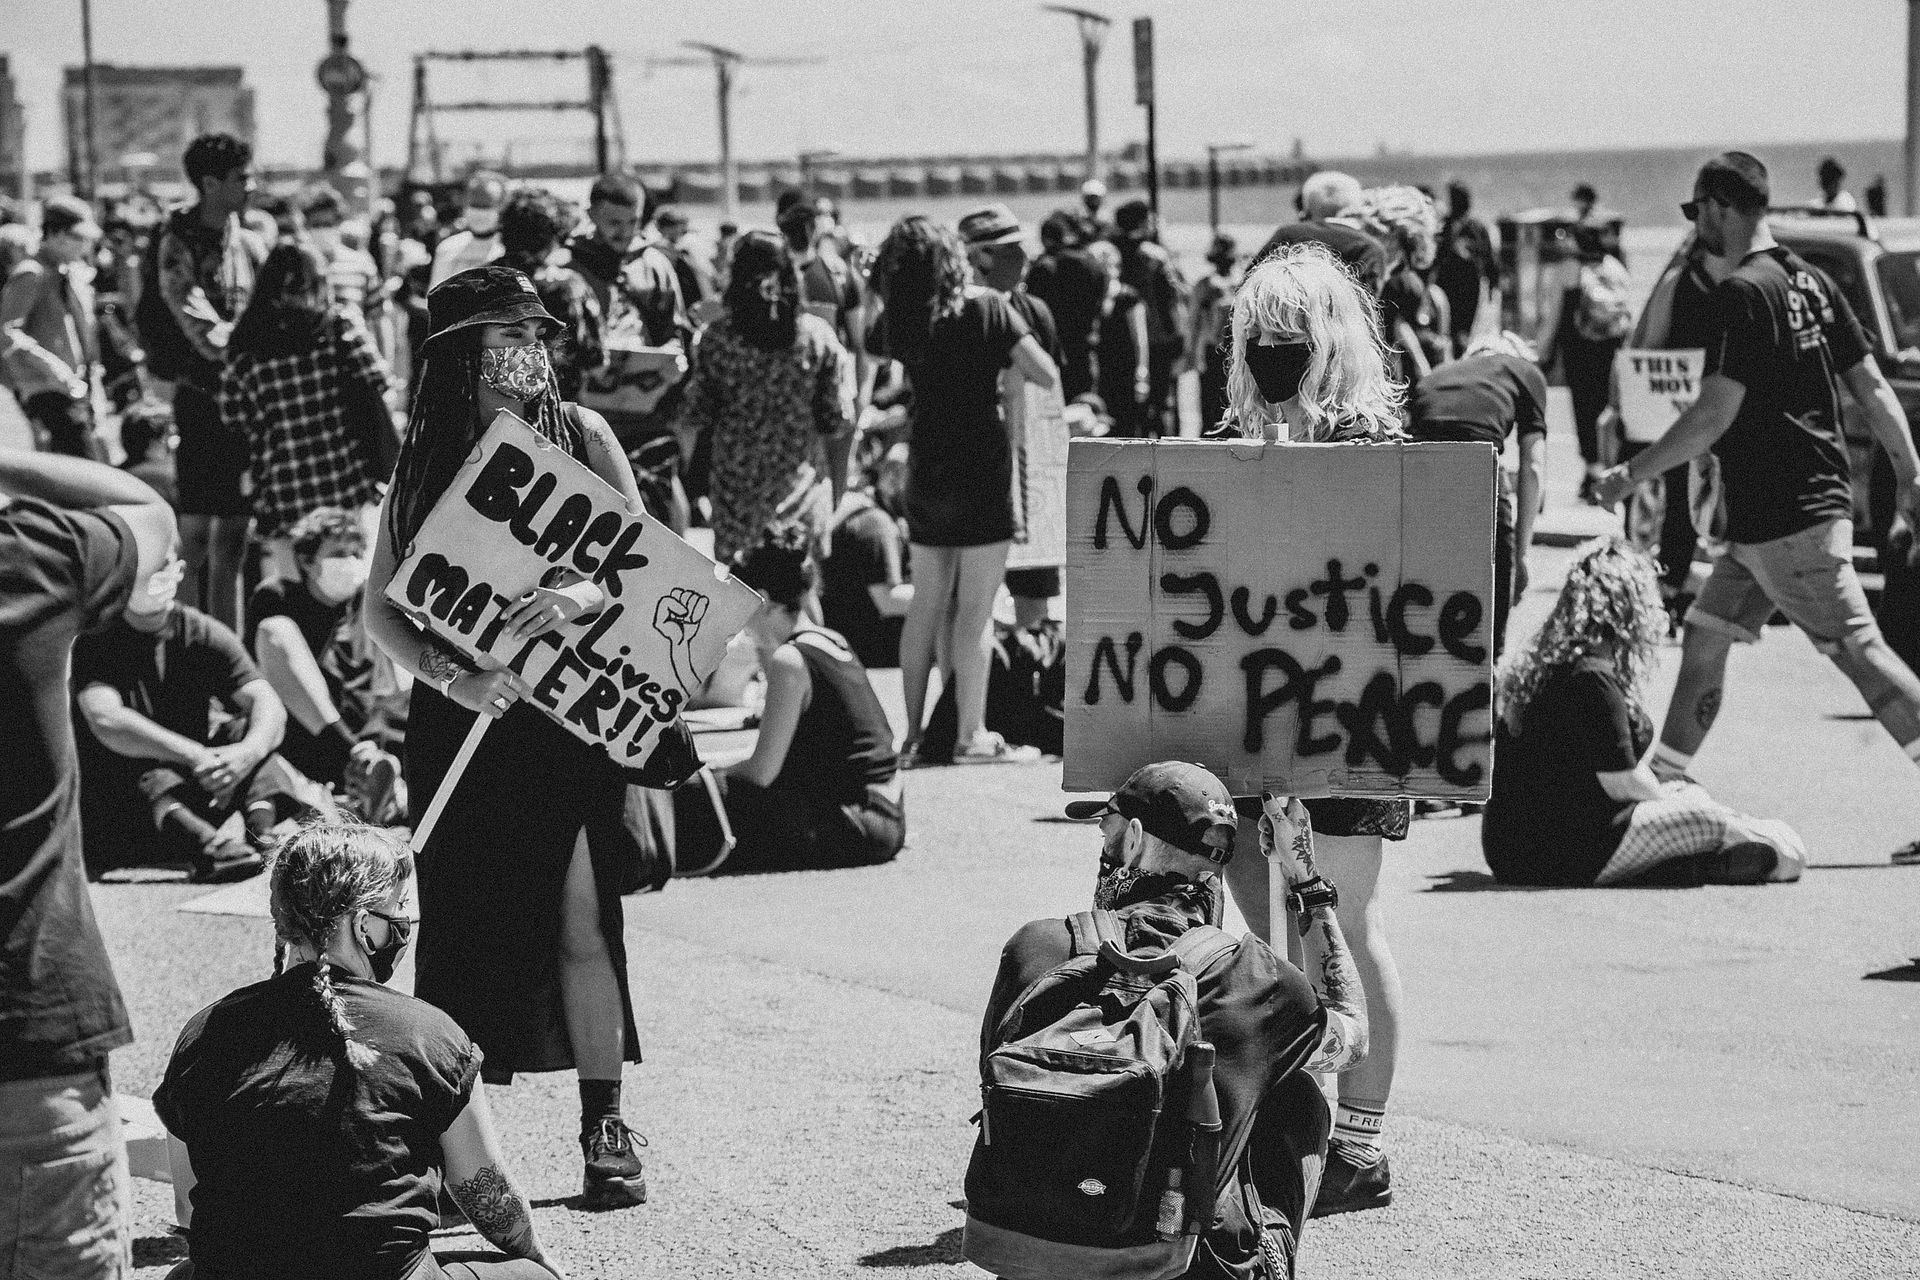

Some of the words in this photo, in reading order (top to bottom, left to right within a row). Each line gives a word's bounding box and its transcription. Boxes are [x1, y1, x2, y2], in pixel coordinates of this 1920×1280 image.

[1631, 358, 1689, 374] THIS
[464, 441, 649, 598] BLACK
[1159, 558, 1487, 665] Justice
[1240, 647, 1492, 787] PEACE
[1349, 1114, 1383, 1127] FRE
